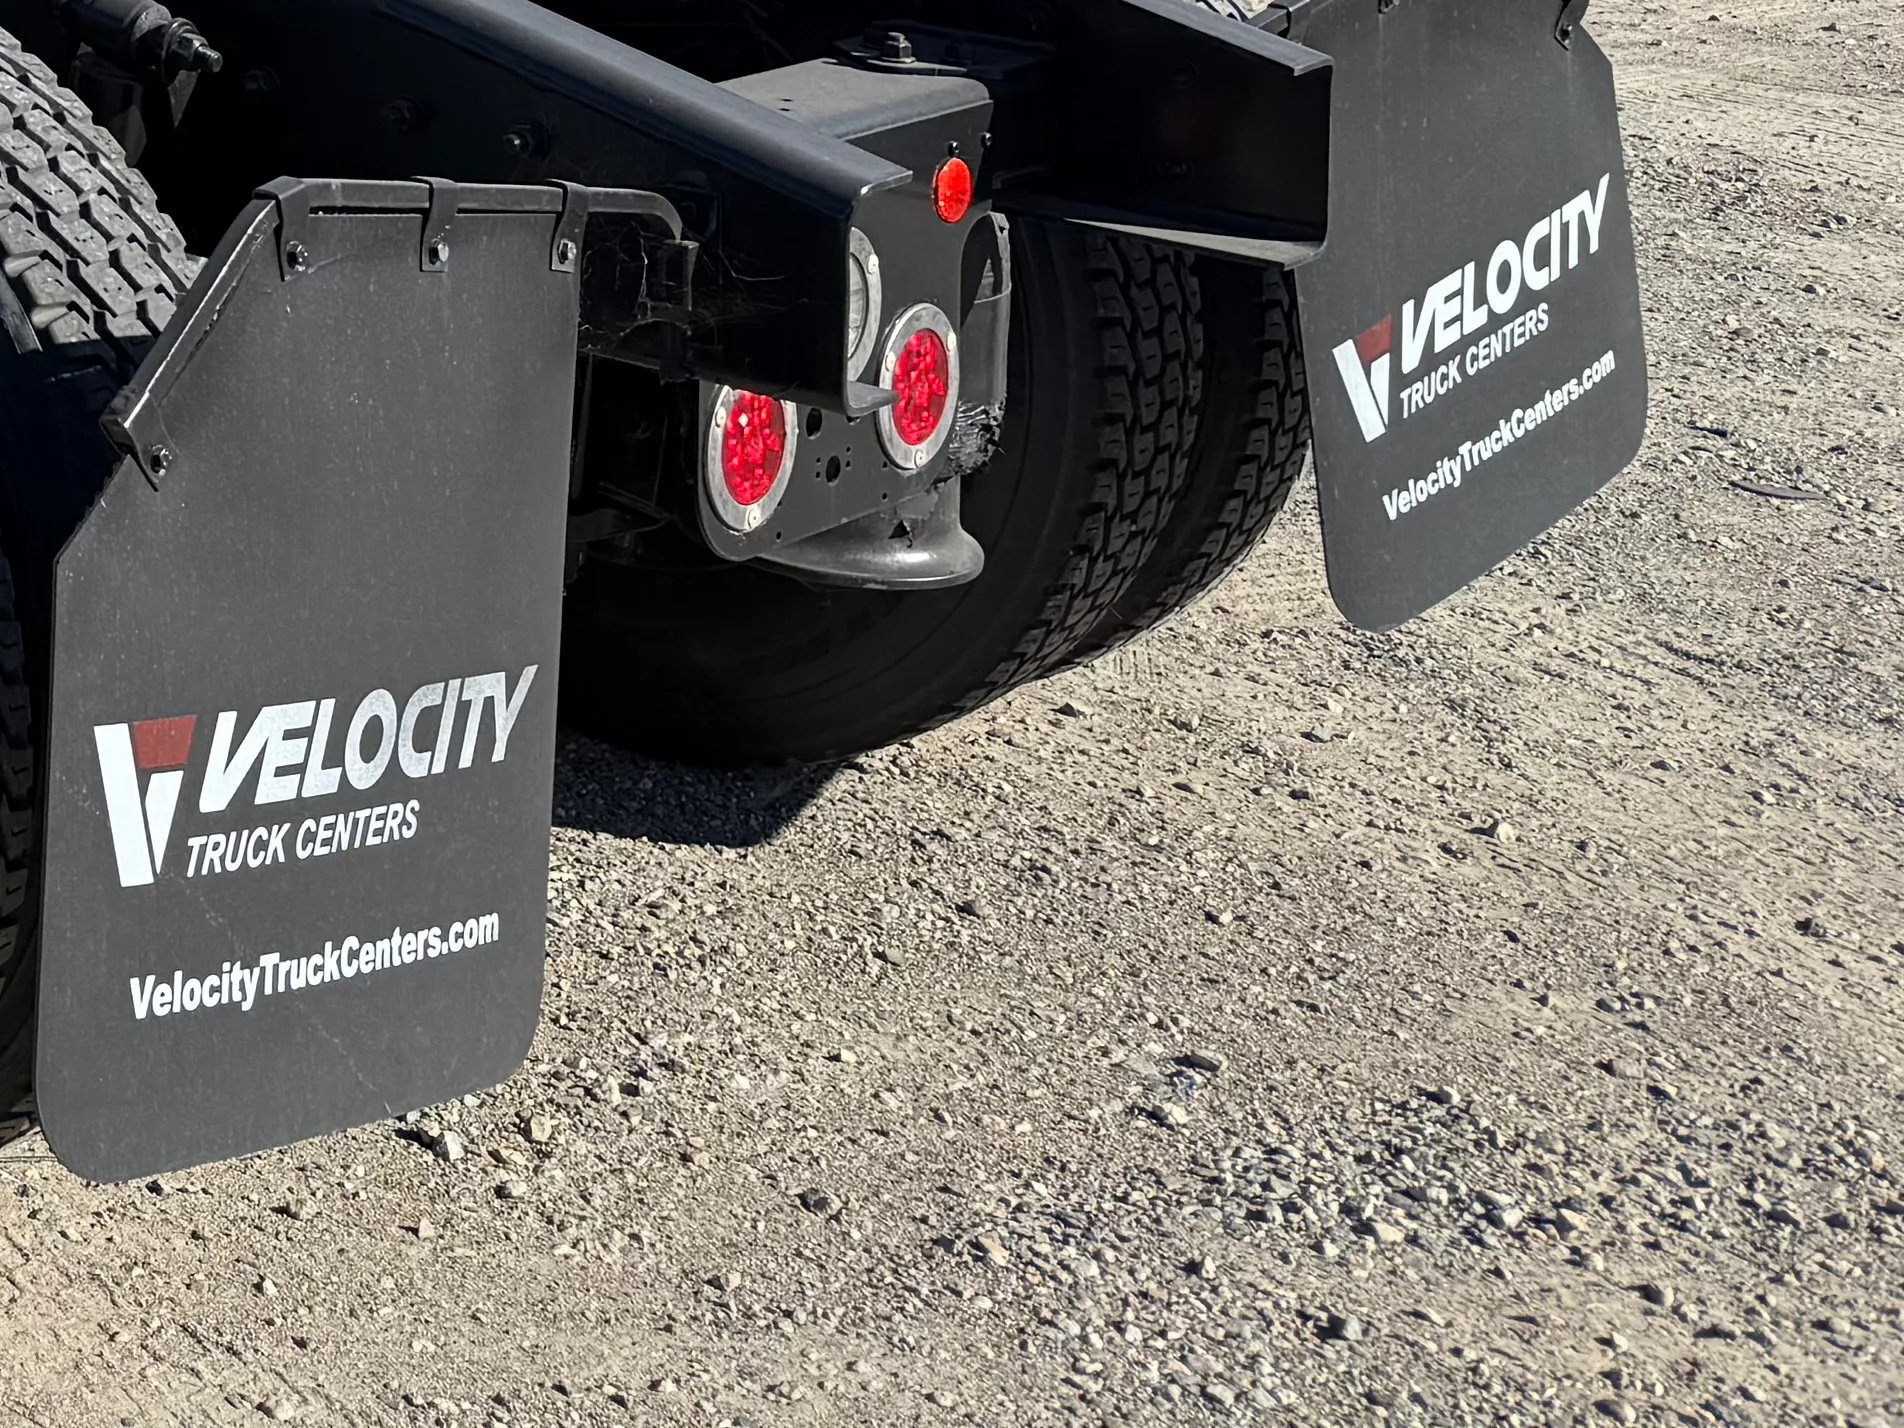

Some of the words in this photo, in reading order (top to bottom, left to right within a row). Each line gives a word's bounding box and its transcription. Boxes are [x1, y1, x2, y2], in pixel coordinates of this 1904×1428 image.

[1400, 172, 1611, 376] VELOCITY
[1399, 355, 1462, 419] TRUCK
[1465, 302, 1549, 376] CENTERS
[1382, 348, 1617, 522] VelocityTruckCenters.com
[198, 663, 539, 814] VELOCITY
[185, 822, 291, 878] TRUCK
[295, 799, 422, 860] CENTERS
[129, 911, 500, 1020] VelocityTruckCenters.com
